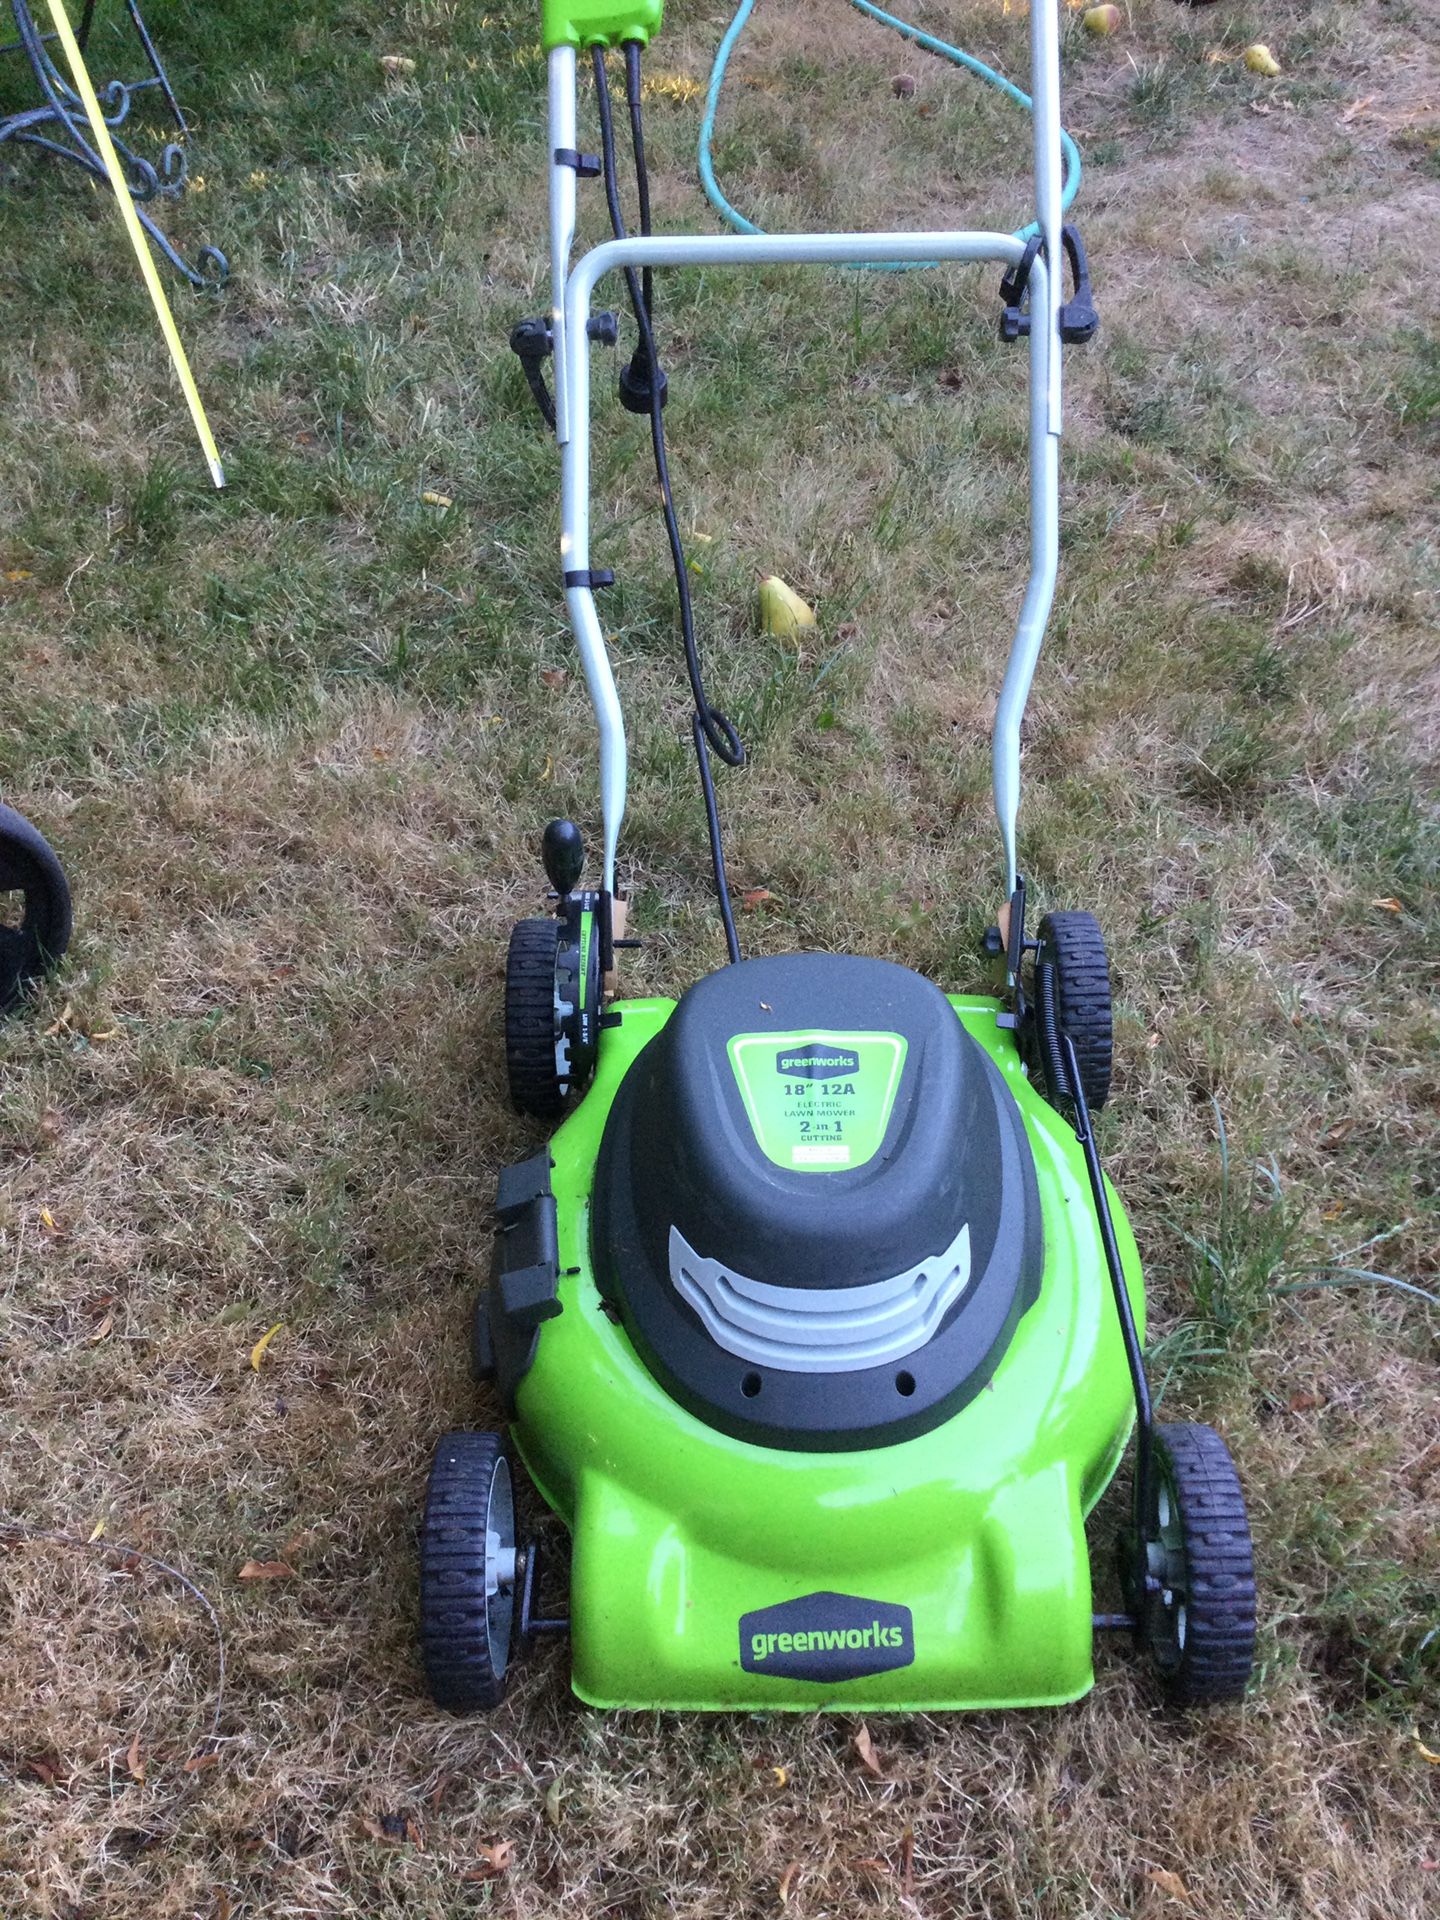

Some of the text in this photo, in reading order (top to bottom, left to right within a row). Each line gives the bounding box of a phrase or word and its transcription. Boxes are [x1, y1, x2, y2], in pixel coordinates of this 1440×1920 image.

[781, 1055, 854, 1069] greenworks
[784, 1083, 855, 1096] 18" 12A
[800, 1121, 811, 1132] 2
[834, 1120, 843, 1132] 1
[751, 1621, 903, 1661] greenworks
